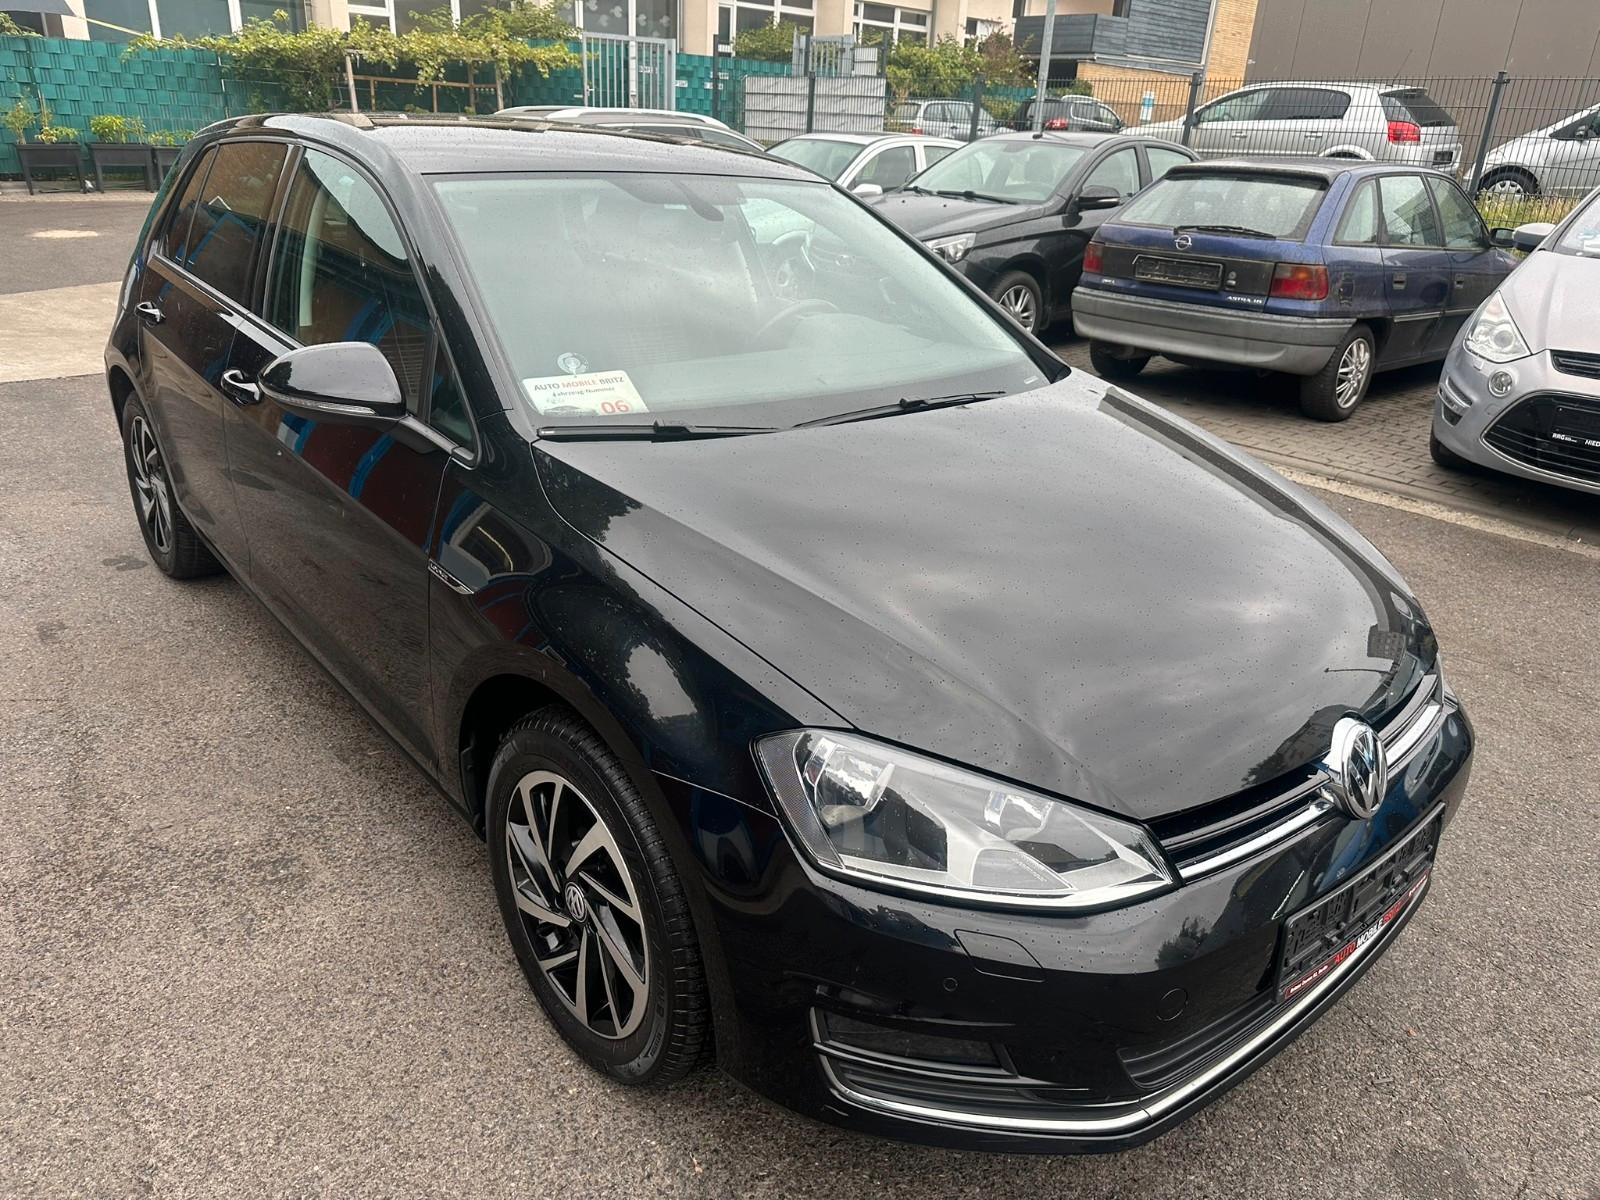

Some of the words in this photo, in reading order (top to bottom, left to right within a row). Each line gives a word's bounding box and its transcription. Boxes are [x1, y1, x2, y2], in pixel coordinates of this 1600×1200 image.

[534, 383, 561, 391] AUTO
[561, 379, 598, 389] MOBILE
[598, 376, 624, 385] BRITZ
[600, 399, 630, 414] 06
[1333, 941, 1356, 964] AUTO
